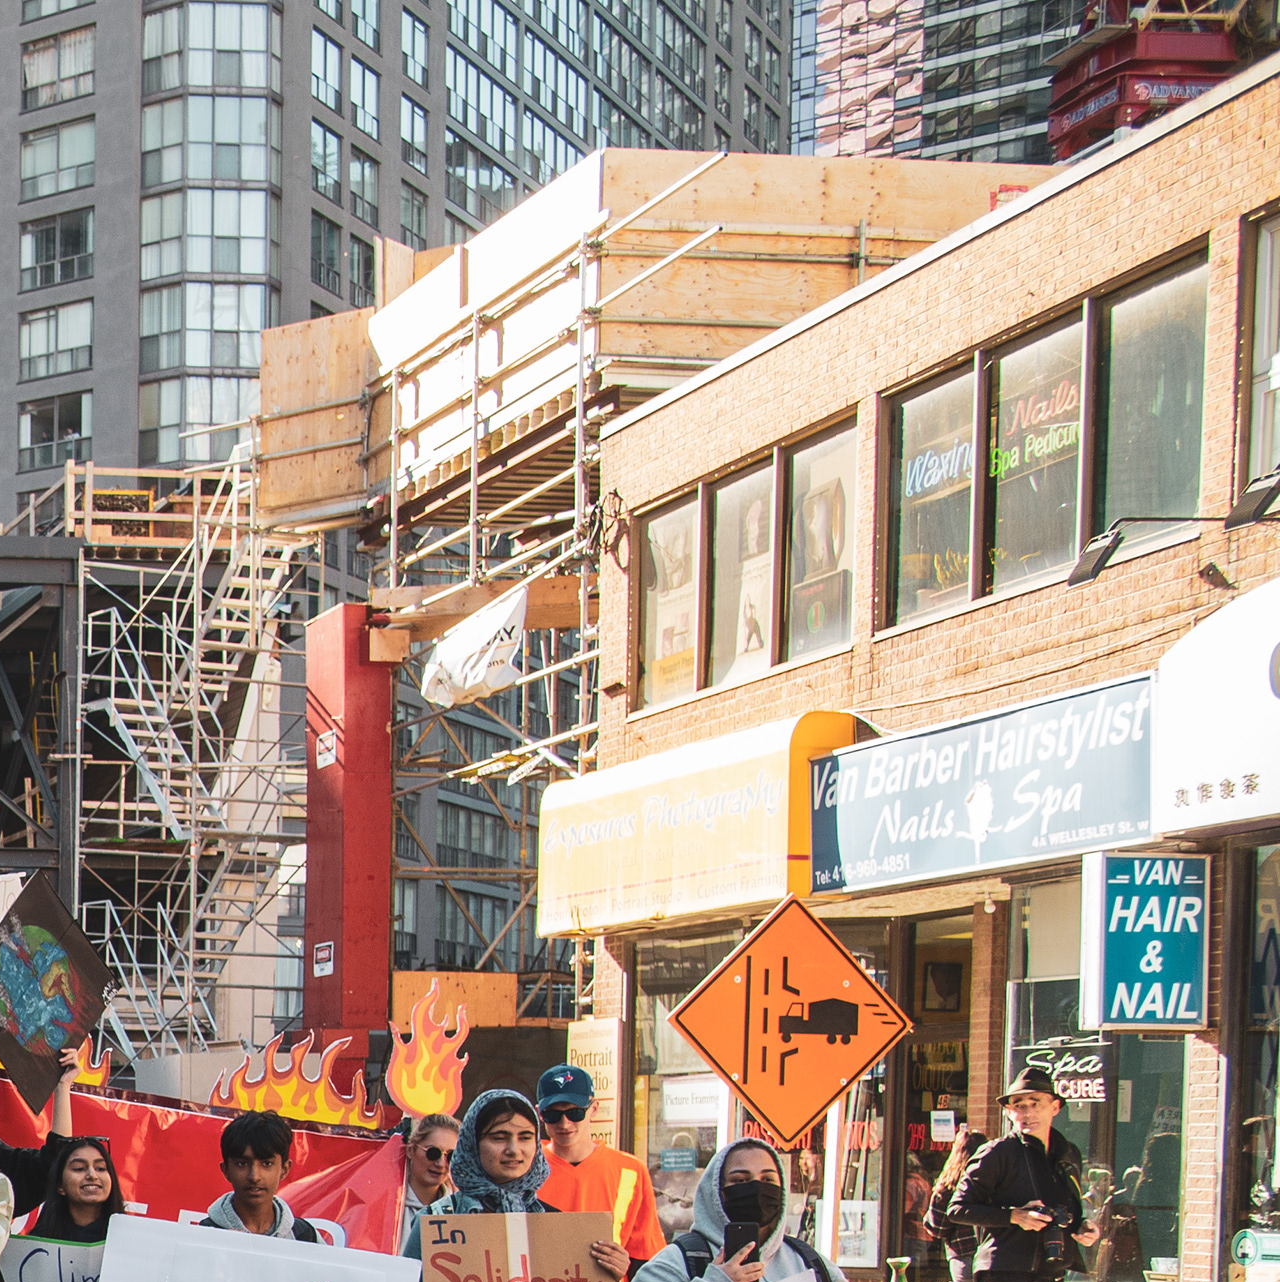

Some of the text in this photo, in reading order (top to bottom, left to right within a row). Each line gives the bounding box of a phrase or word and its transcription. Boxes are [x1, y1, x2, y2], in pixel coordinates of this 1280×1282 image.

[1151, 85, 1215, 99] ADVANC
[1006, 379, 1079, 436] Nails
[991, 421, 1080, 479] Spa Pedicur
[812, 686, 1151, 811] Van Barber Hairstylist
[642, 770, 785, 834] Photography
[870, 769, 1083, 859] Nails Spa
[1048, 822, 1115, 848] WELLESLEY
[697, 871, 785, 900] Custom Framing
[815, 852, 911, 886] Tel: 416-960-4851
[1133, 858, 1183, 886] VAN
[1108, 896, 1204, 935] HAIR
[1139, 940, 1164, 974] &
[1109, 981, 1200, 1021] NAIL
[570, 1047, 613, 1068] Portrait
[1025, 1049, 1104, 1082] Spa
[665, 1092, 720, 1109] Picture Framing
[429, 1219, 466, 1244] In
